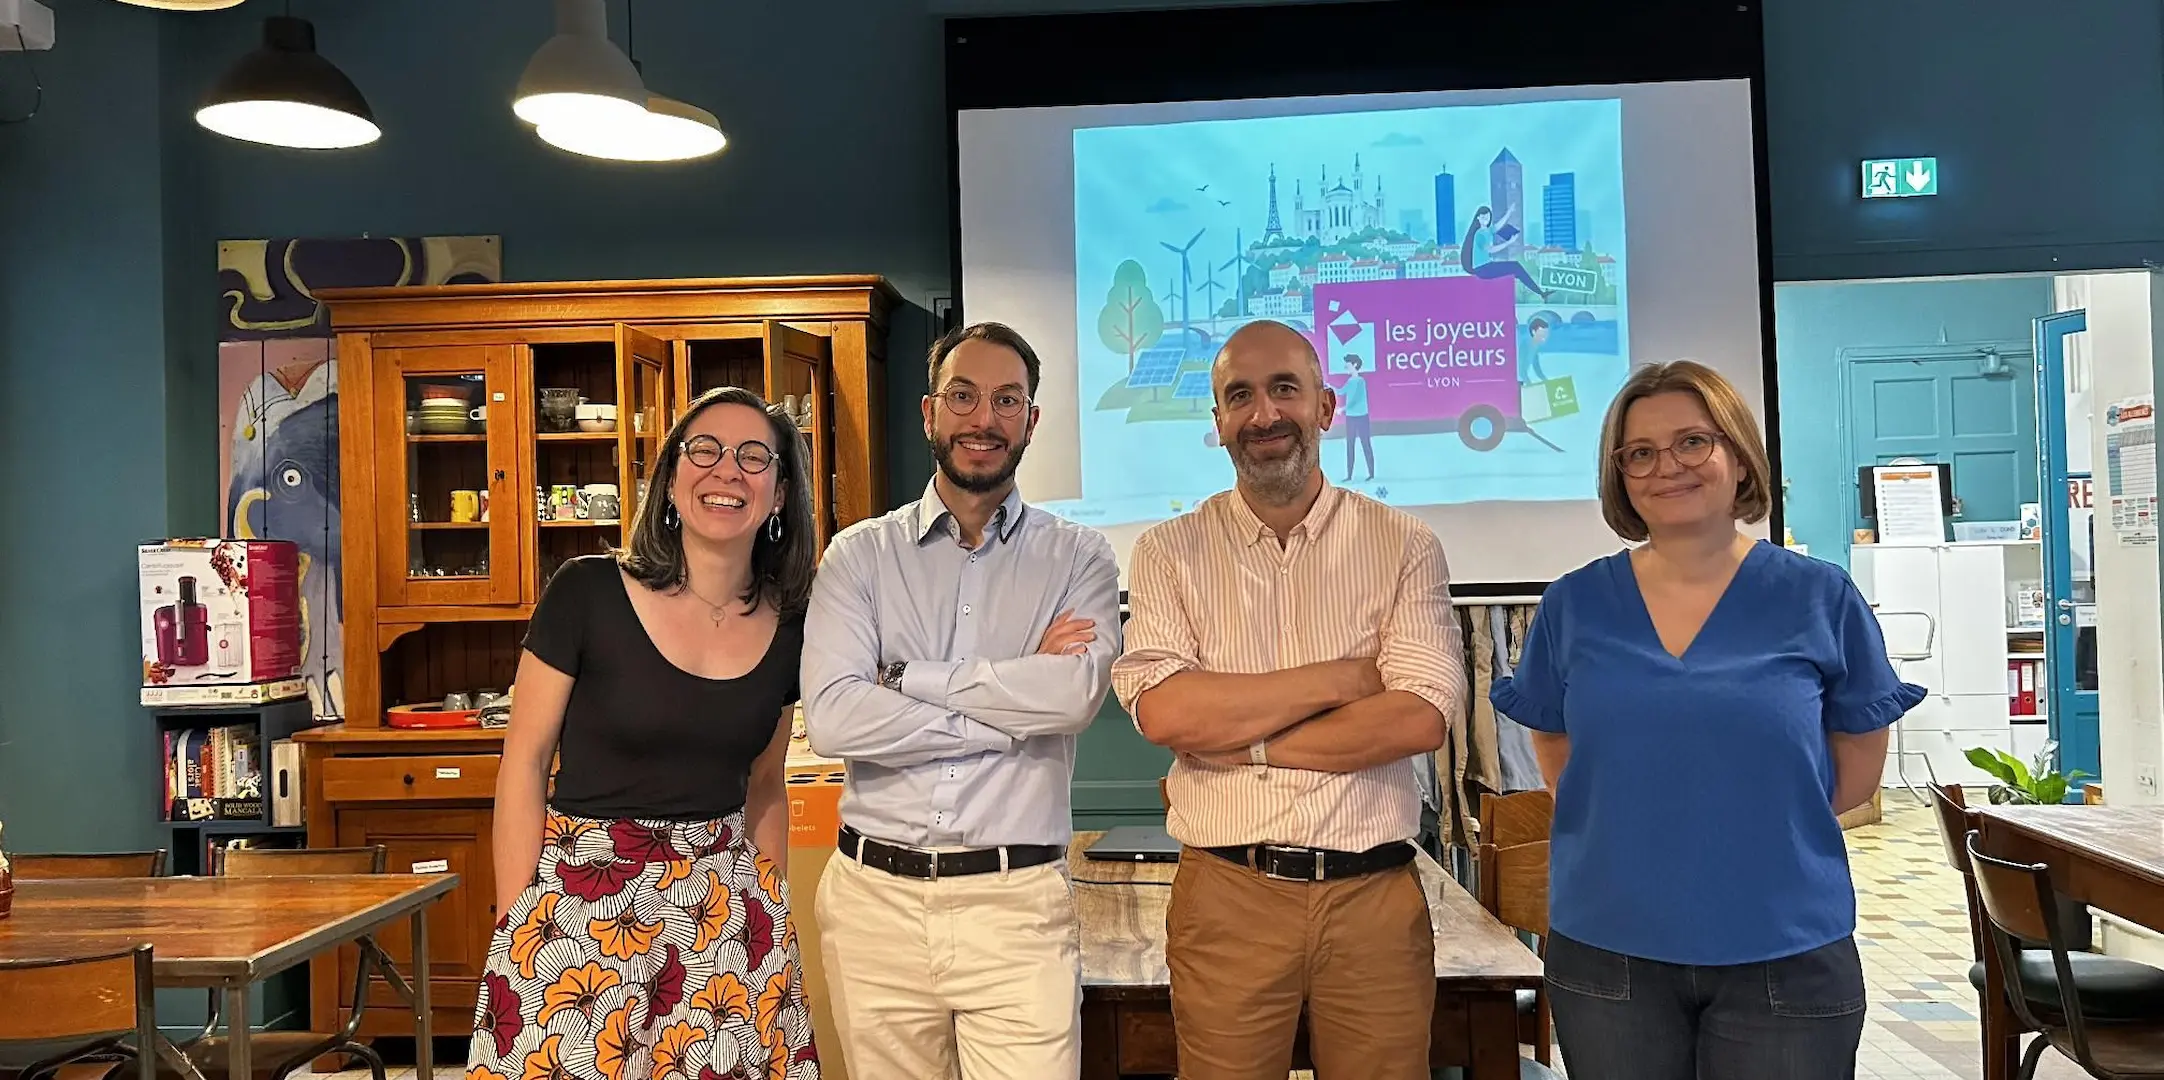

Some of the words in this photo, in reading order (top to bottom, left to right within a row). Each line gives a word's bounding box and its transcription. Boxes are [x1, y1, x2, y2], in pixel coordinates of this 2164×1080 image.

[1550, 272, 1586, 288] LYON
[1385, 319, 1417, 342] les
[1423, 318, 1505, 346] joyeux
[1386, 344, 1506, 374] recycleurs
[1427, 376, 1460, 388] LYON
